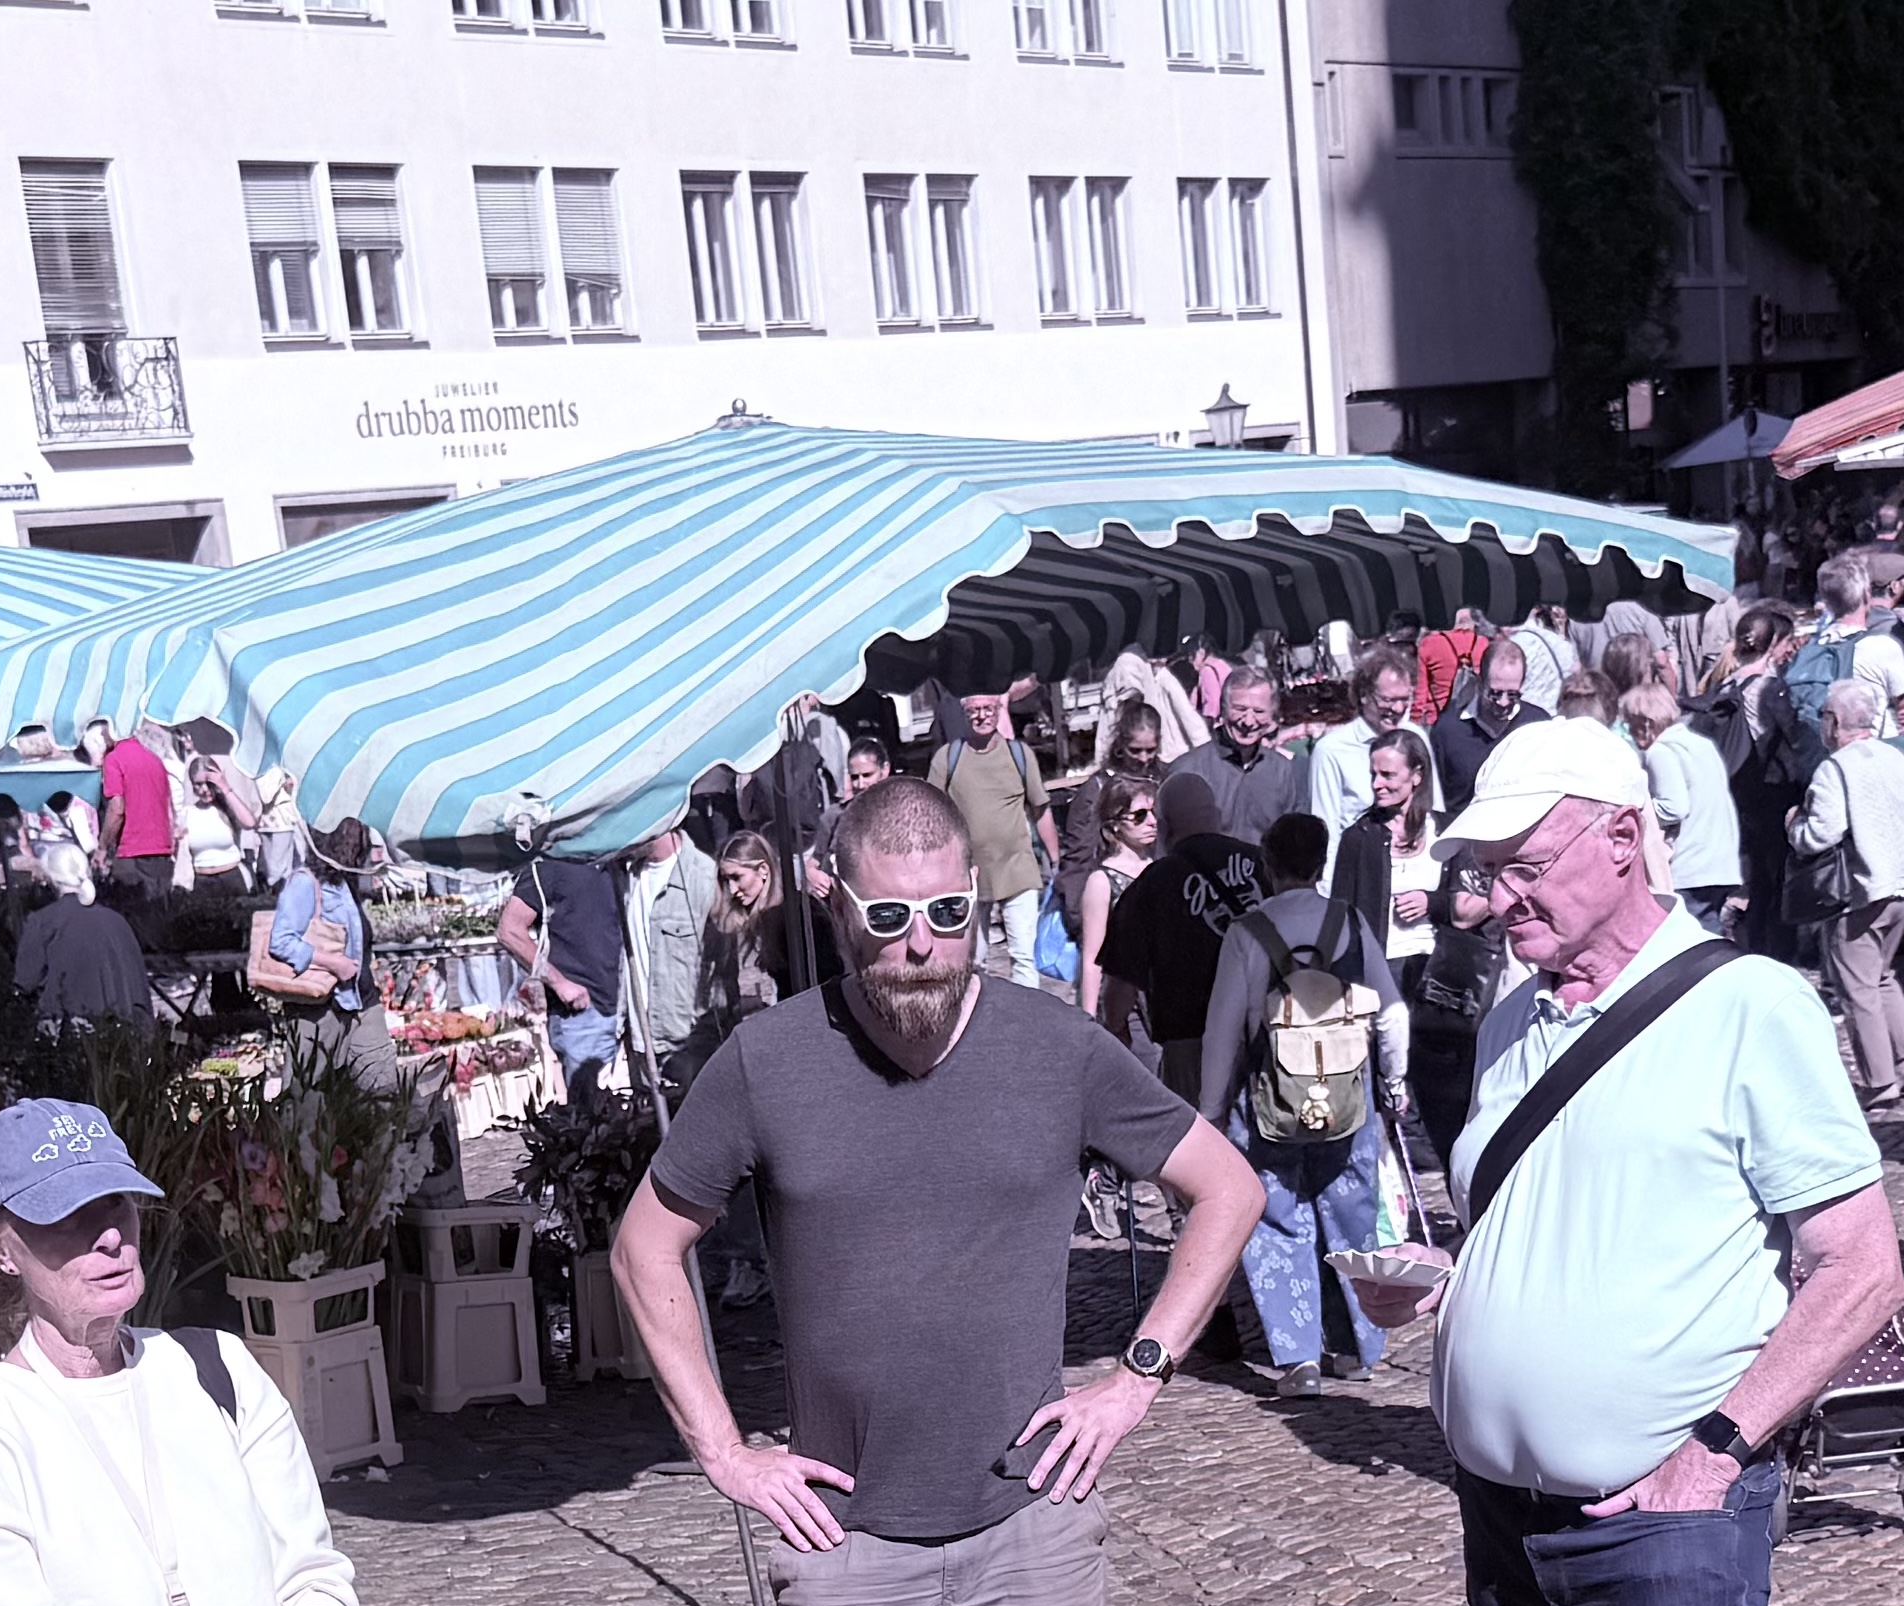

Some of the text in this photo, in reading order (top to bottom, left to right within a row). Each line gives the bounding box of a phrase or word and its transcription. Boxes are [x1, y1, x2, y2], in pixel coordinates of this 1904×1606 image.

[435, 381, 499, 398] JUWELIER
[356, 398, 579, 439] drubba moments
[442, 442, 507, 458] FREIBURG
